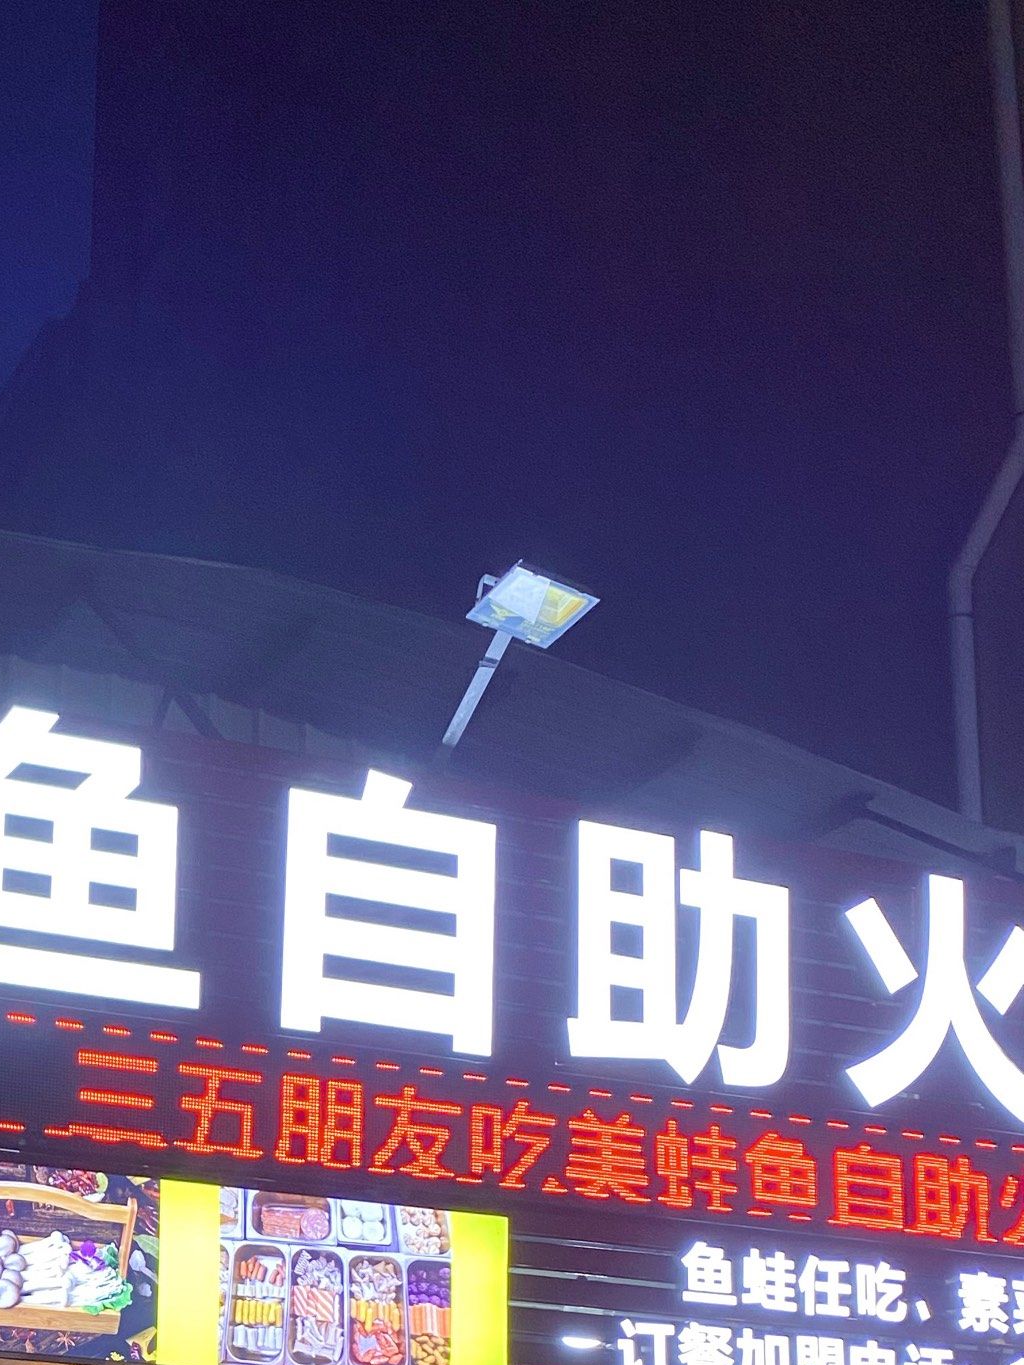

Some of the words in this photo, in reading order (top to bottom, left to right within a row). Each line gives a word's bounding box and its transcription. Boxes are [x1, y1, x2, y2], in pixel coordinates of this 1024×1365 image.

[681, 1241, 1024, 1334] 鱼蛙任吃、素
